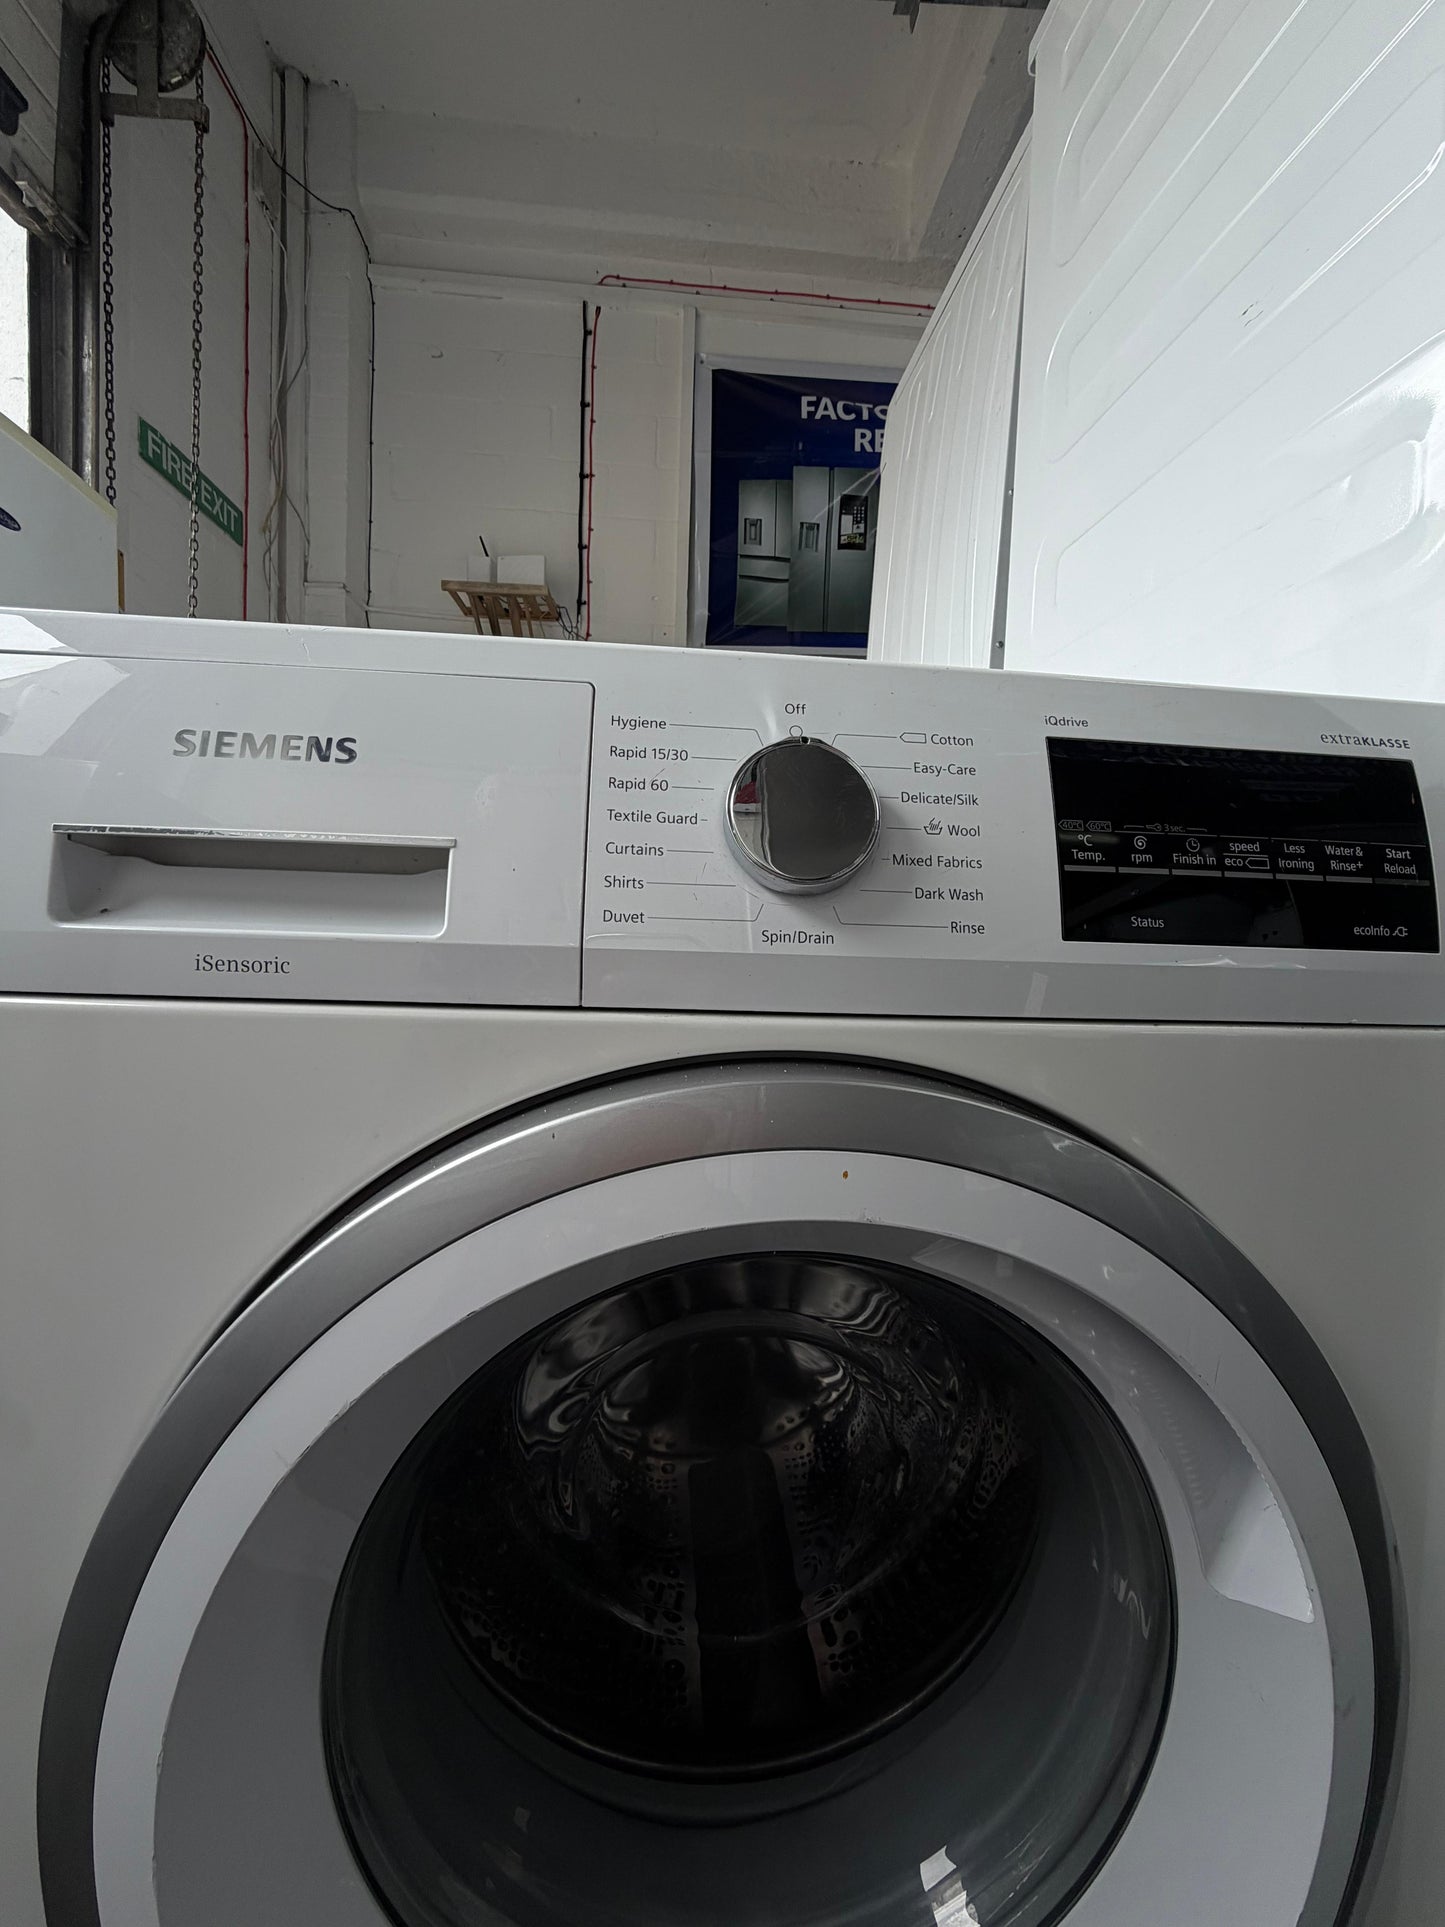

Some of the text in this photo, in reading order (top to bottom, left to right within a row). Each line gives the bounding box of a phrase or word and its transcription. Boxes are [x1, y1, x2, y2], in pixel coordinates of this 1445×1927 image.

[147, 429, 238, 532] FIRE EXIT
[785, 703, 806, 715] Off
[610, 715, 667, 730] Hygiene
[1044, 715, 1089, 728] iQdrive
[173, 729, 358, 764] SIEMENS
[930, 733, 974, 747] Cotton
[1320, 732, 1411, 750] extraKLASSE
[609, 745, 689, 762] Rapid 15/30
[913, 763, 977, 777] Easy-Care
[608, 777, 669, 792] Rapid 60
[900, 791, 979, 806] Delicate/Silk
[607, 809, 698, 825] Textile Guard
[947, 824, 981, 837] Wool
[605, 842, 664, 857] Curtains
[1229, 842, 1260, 853] speed
[1283, 843, 1306, 854] Less
[1325, 845, 1363, 856] Water &
[1385, 848, 1411, 859] Start
[892, 854, 983, 869] Mixed Fabrics
[1071, 849, 1106, 863] Temp.
[1131, 854, 1153, 864] rpm
[1173, 853, 1216, 865] Finish in
[1224, 857, 1244, 867] eco
[1278, 858, 1315, 872] Ironing
[1330, 860, 1364, 871] Rinse+
[1384, 863, 1417, 875] Reload
[604, 875, 645, 889] Shirts
[914, 887, 984, 901] Dark Wash
[602, 909, 645, 924] Duvet
[1131, 915, 1165, 929] Status
[950, 921, 985, 934] Rinse
[1353, 925, 1390, 936] ecoInfo
[761, 929, 835, 947] Spin/Drain
[194, 954, 291, 975] iSensoric
